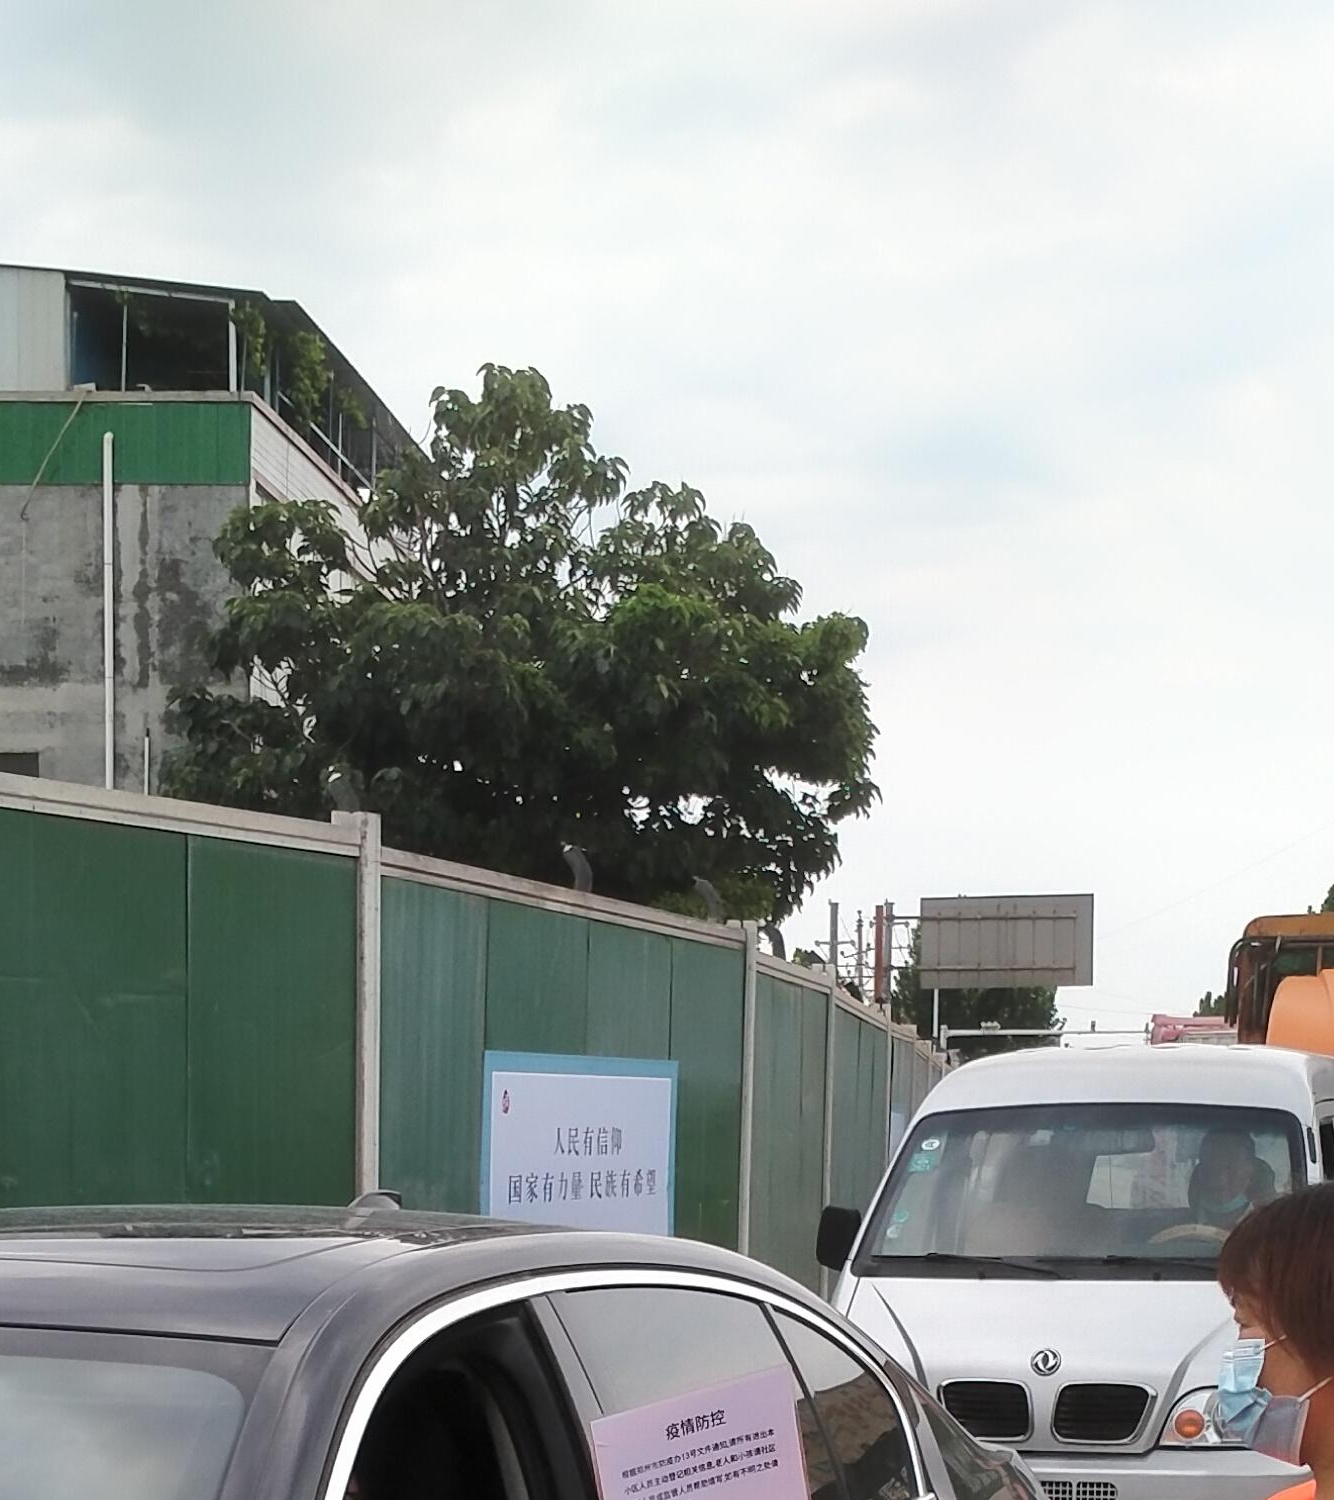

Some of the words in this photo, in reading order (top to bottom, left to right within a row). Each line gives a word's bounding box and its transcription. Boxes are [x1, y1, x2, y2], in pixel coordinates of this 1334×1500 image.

[553, 1126, 623, 1156] 人民有信仰
[508, 1171, 584, 1205] 国家有力量
[590, 1168, 657, 1200] 民族有希望
[665, 1409, 727, 1441] 疫情防控
